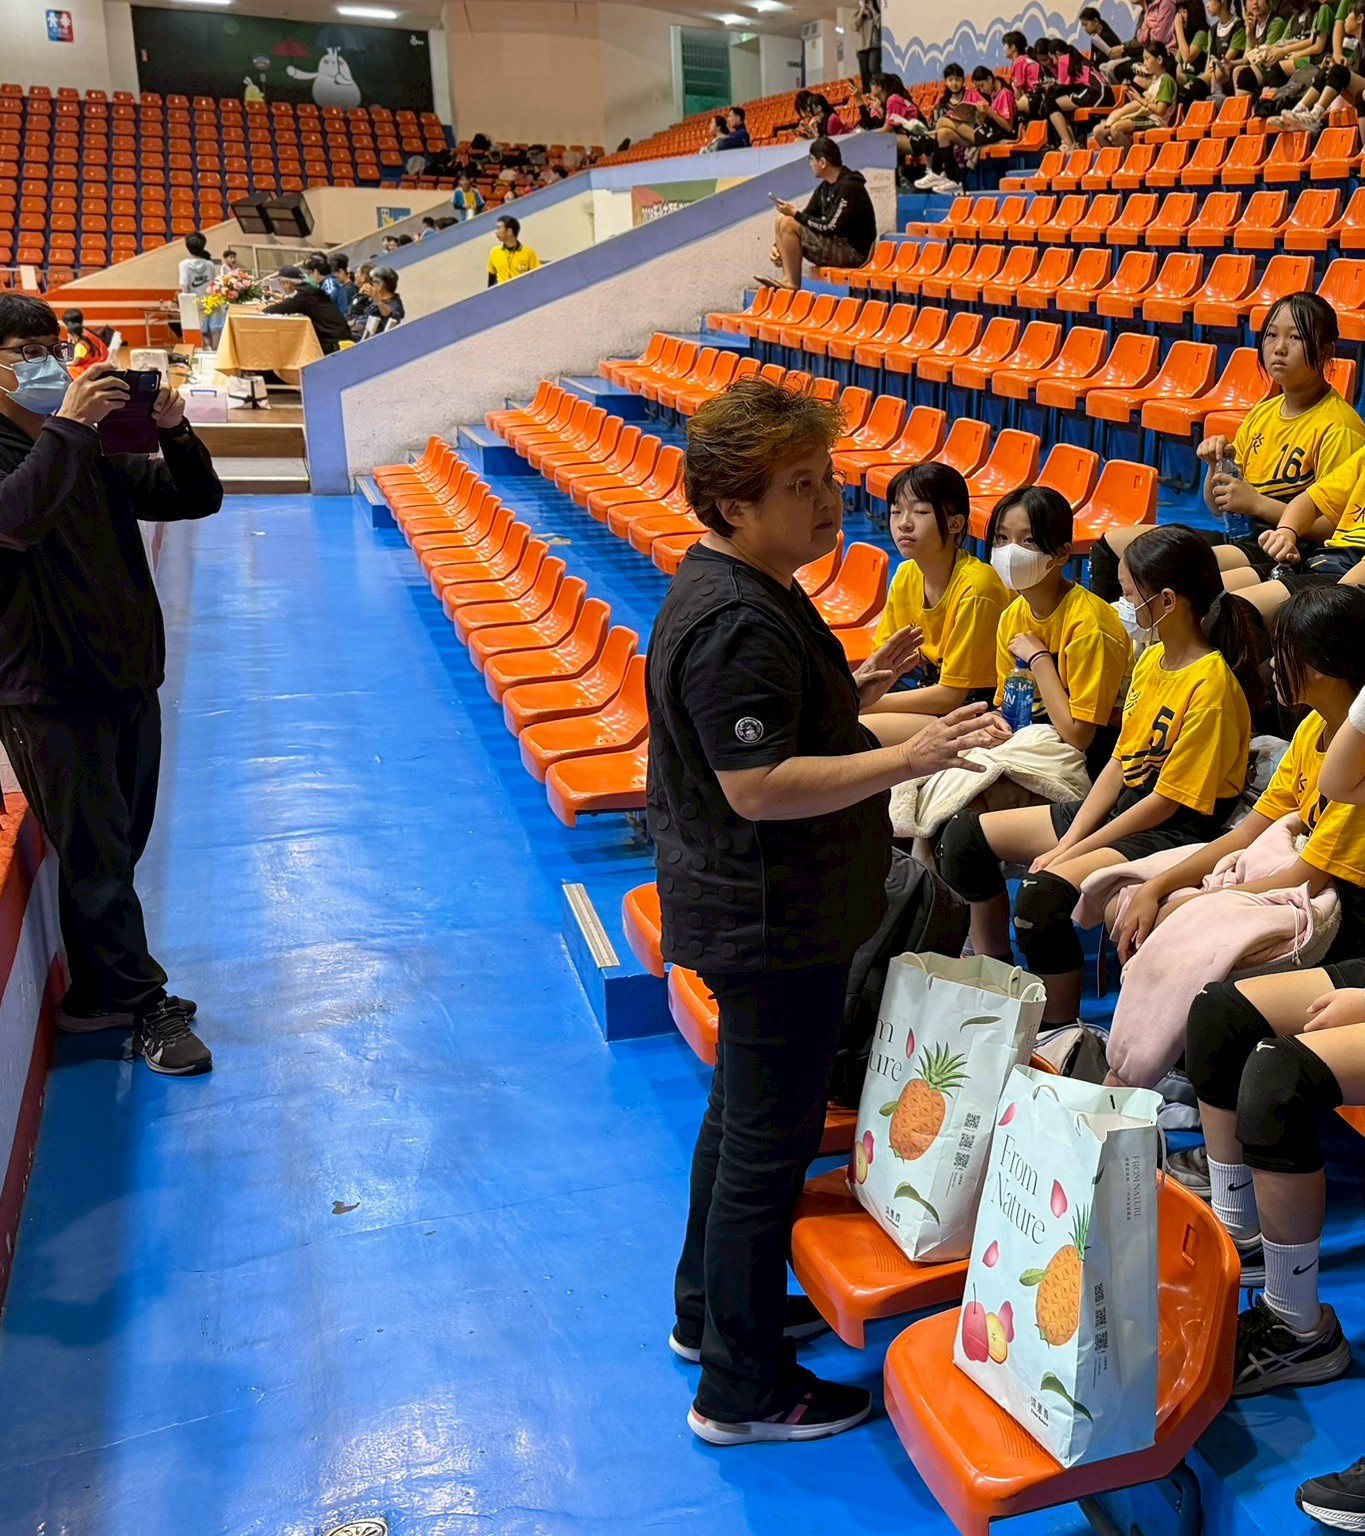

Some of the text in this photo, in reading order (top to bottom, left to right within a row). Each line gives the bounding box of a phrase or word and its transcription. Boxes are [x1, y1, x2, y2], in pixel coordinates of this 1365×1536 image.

[1272, 443, 1306, 484] 16
[1148, 705, 1175, 756] 5
[999, 1133, 1039, 1196] From
[1132, 1155, 1142, 1217] FROM NATURE
[991, 1170, 1047, 1245] Nature
